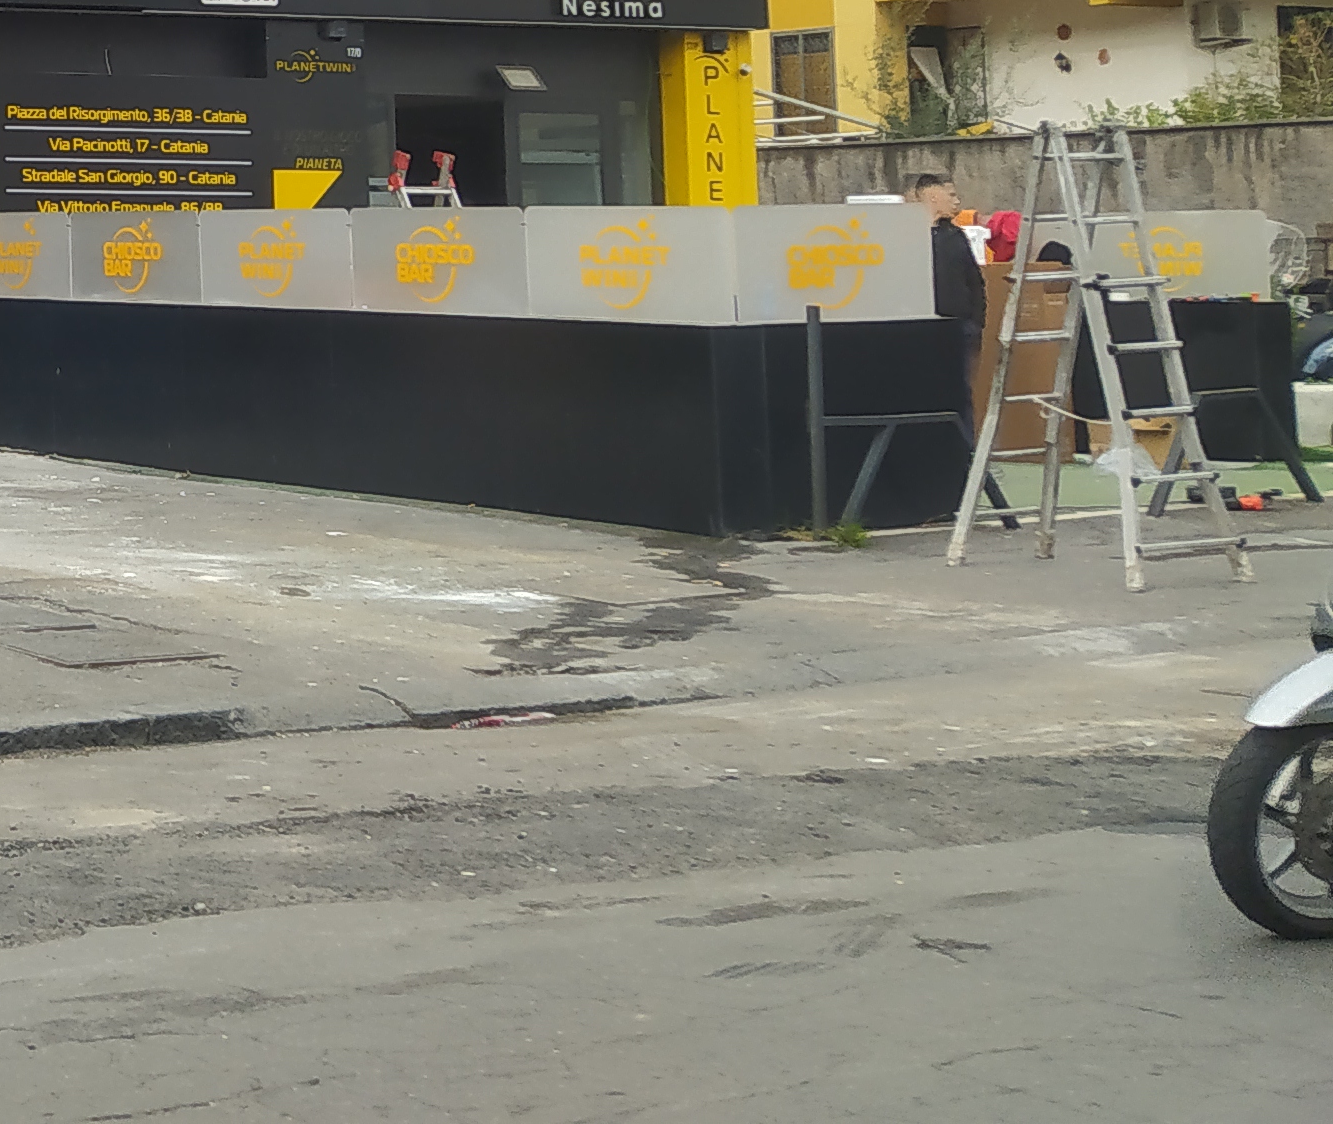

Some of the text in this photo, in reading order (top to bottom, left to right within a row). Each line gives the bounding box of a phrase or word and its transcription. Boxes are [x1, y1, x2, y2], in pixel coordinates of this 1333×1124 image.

[7, 106, 47, 119] Piazza
[49, 107, 67, 120] del
[69, 107, 151, 123] Risorgimento,
[153, 109, 193, 124] 36/38
[203, 110, 247, 124] Catania
[48, 137, 70, 151] Via
[73, 138, 133, 153] Pacinotti,
[136, 140, 149, 152] 17
[161, 140, 209, 154] Catania
[295, 157, 343, 170] PIANETA
[22, 169, 76, 183] Stradale
[78, 170, 105, 183] San
[107, 170, 156, 187] Giorgio,
[159, 171, 177, 184] 90
[188, 172, 236, 185] Catania
[37, 201, 59, 213] Via
[61, 201, 109, 213] Vittorio
[103, 242, 163, 260] CHIOSCO
[238, 242, 306, 260] PLANET
[395, 243, 475, 265] CHIOSCO
[579, 245, 670, 266] PLANET
[104, 260, 133, 277] BAR
[396, 264, 433, 284] BAR
